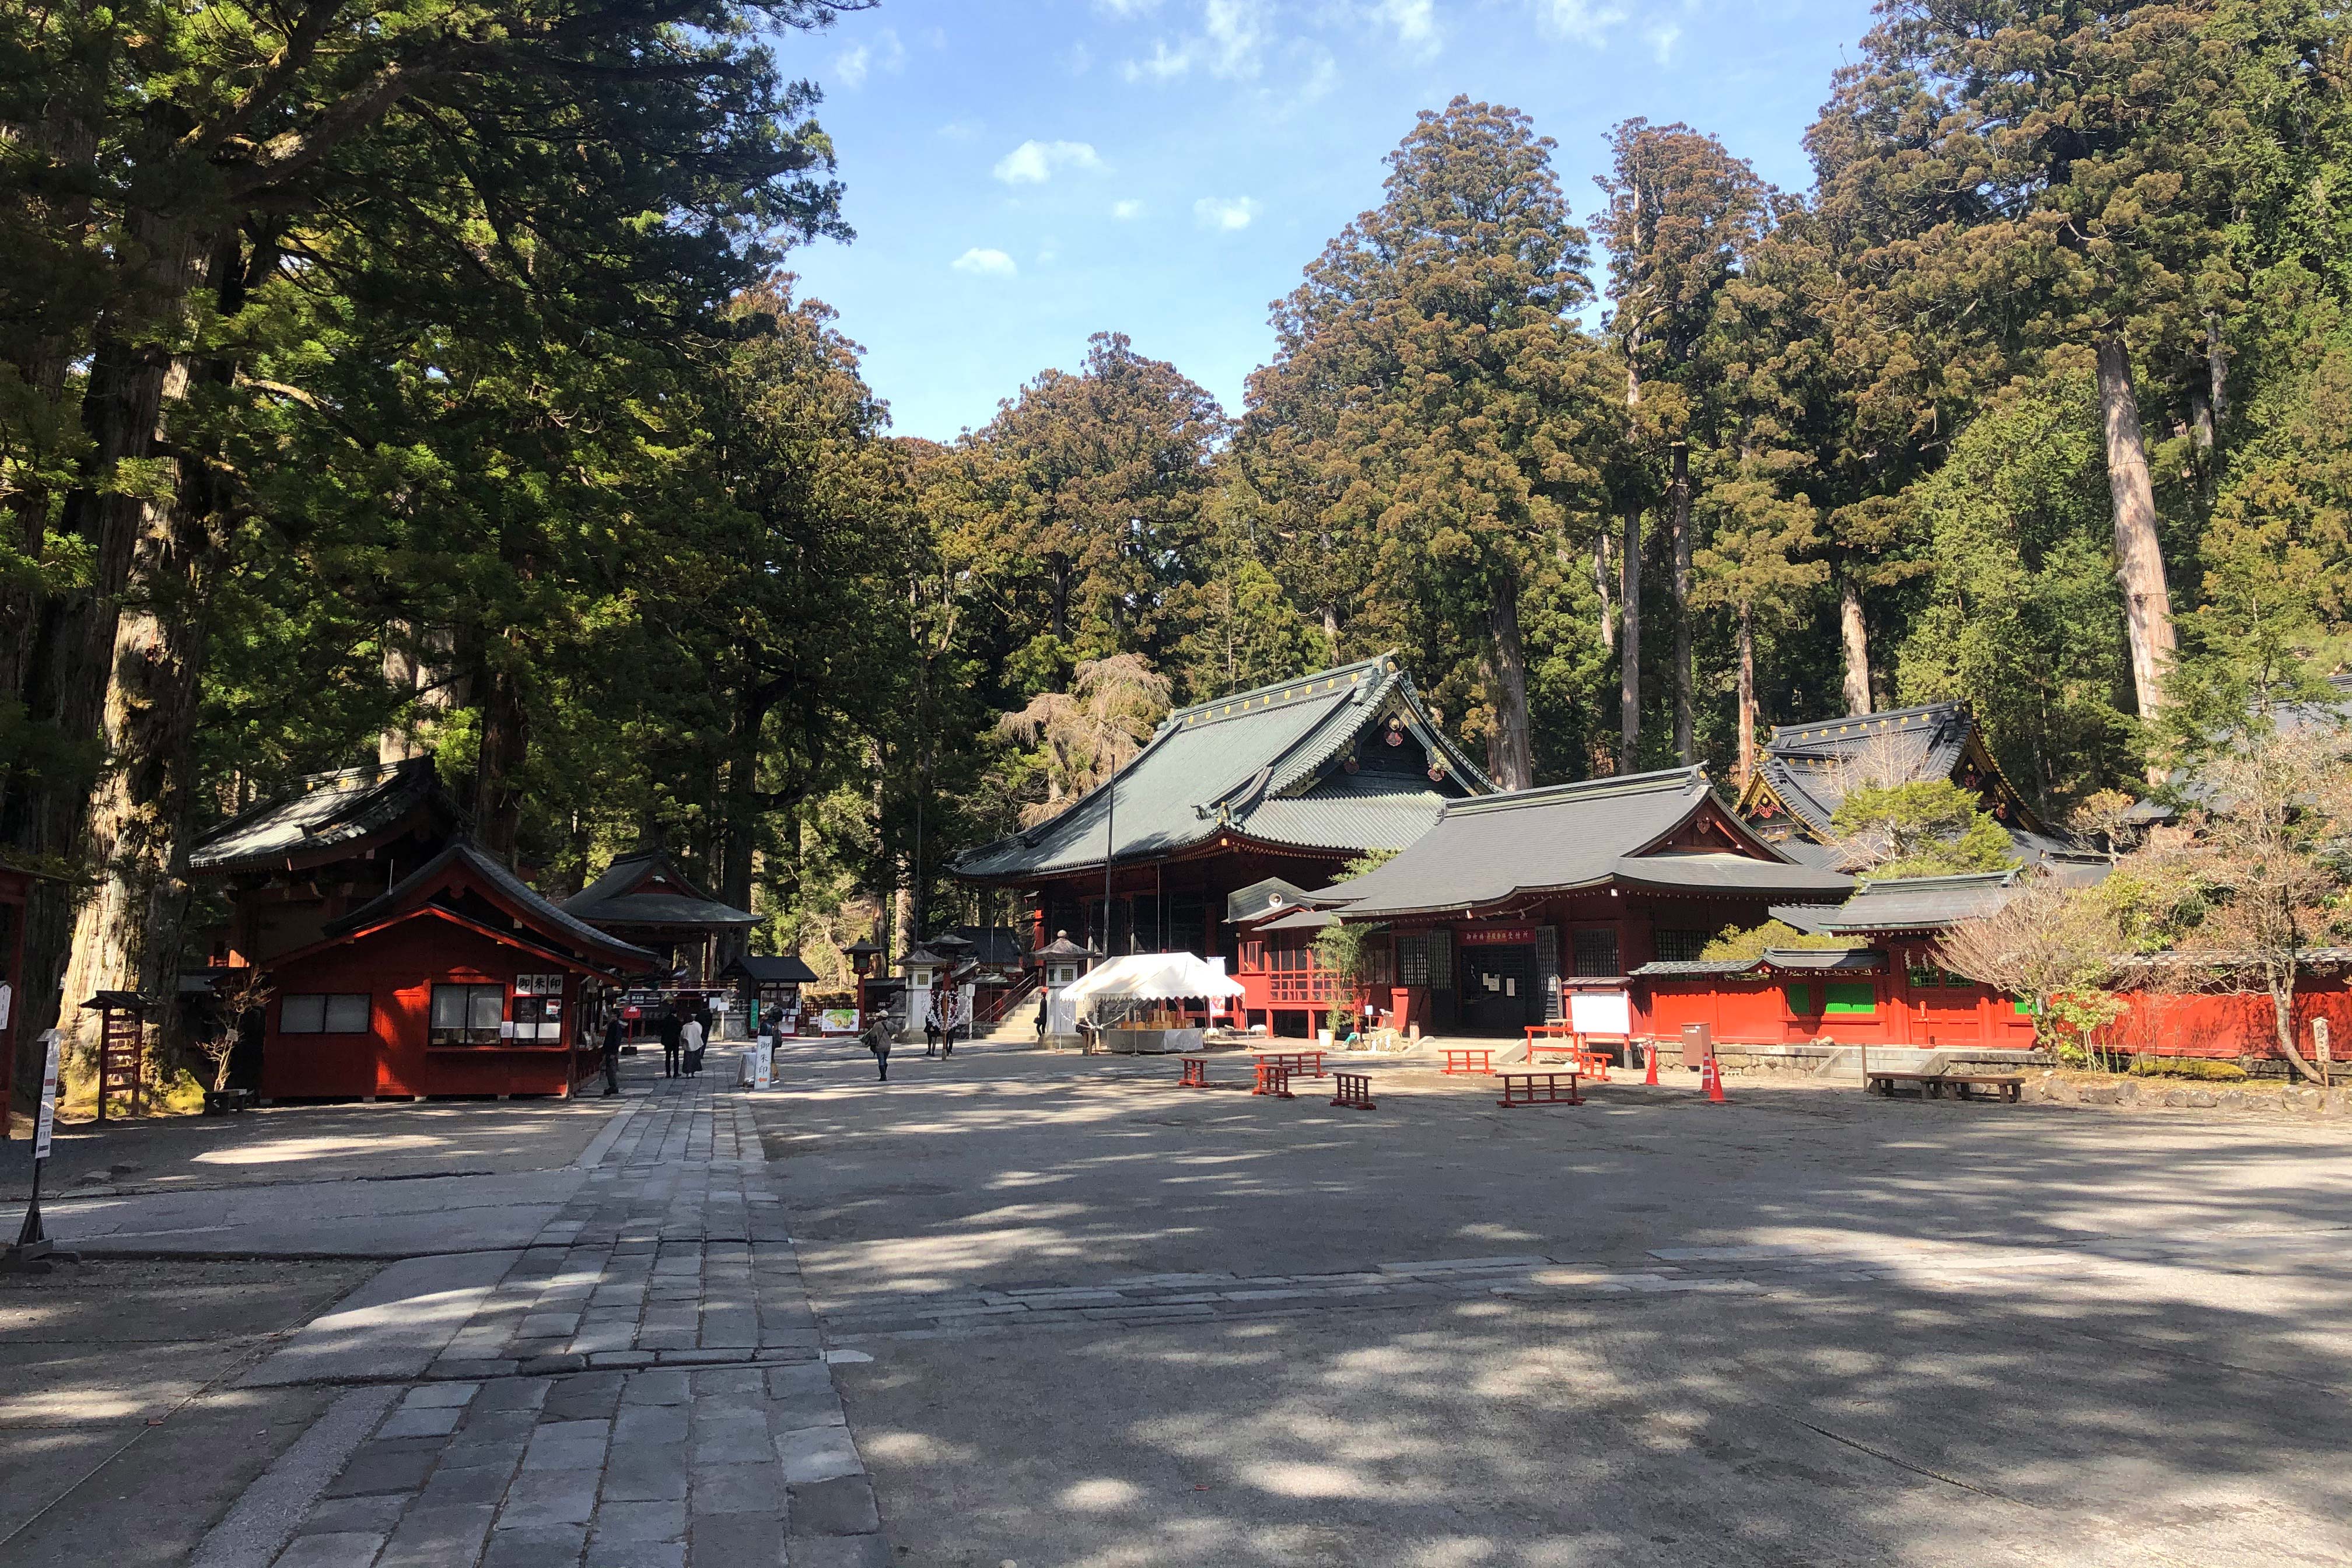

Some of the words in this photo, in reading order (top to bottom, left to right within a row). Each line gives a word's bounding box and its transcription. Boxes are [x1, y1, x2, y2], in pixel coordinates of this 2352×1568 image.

[517, 978, 561, 989] 御朱印
[759, 1041, 769, 1075] 御朱印
